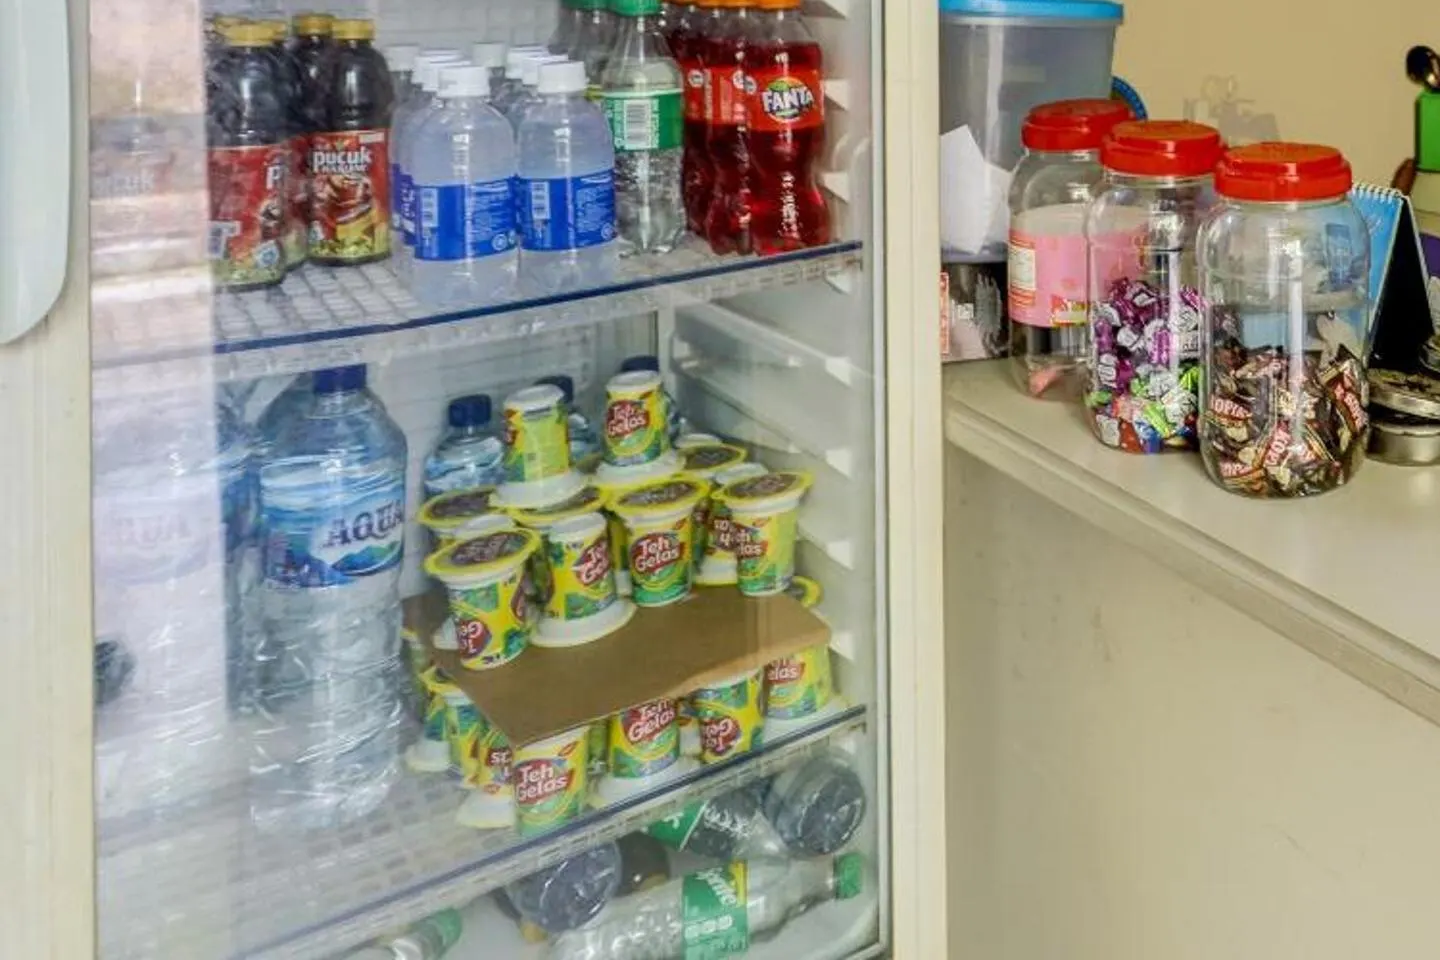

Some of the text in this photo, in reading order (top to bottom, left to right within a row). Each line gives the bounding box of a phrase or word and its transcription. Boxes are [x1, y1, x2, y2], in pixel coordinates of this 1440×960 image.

[313, 146, 371, 174] pucuk
[638, 537, 670, 555] Teh
[635, 547, 679, 572] Gelas
[629, 709, 676, 741] Gelas
[521, 763, 554, 783] Teh
[517, 775, 568, 801] Gelas
